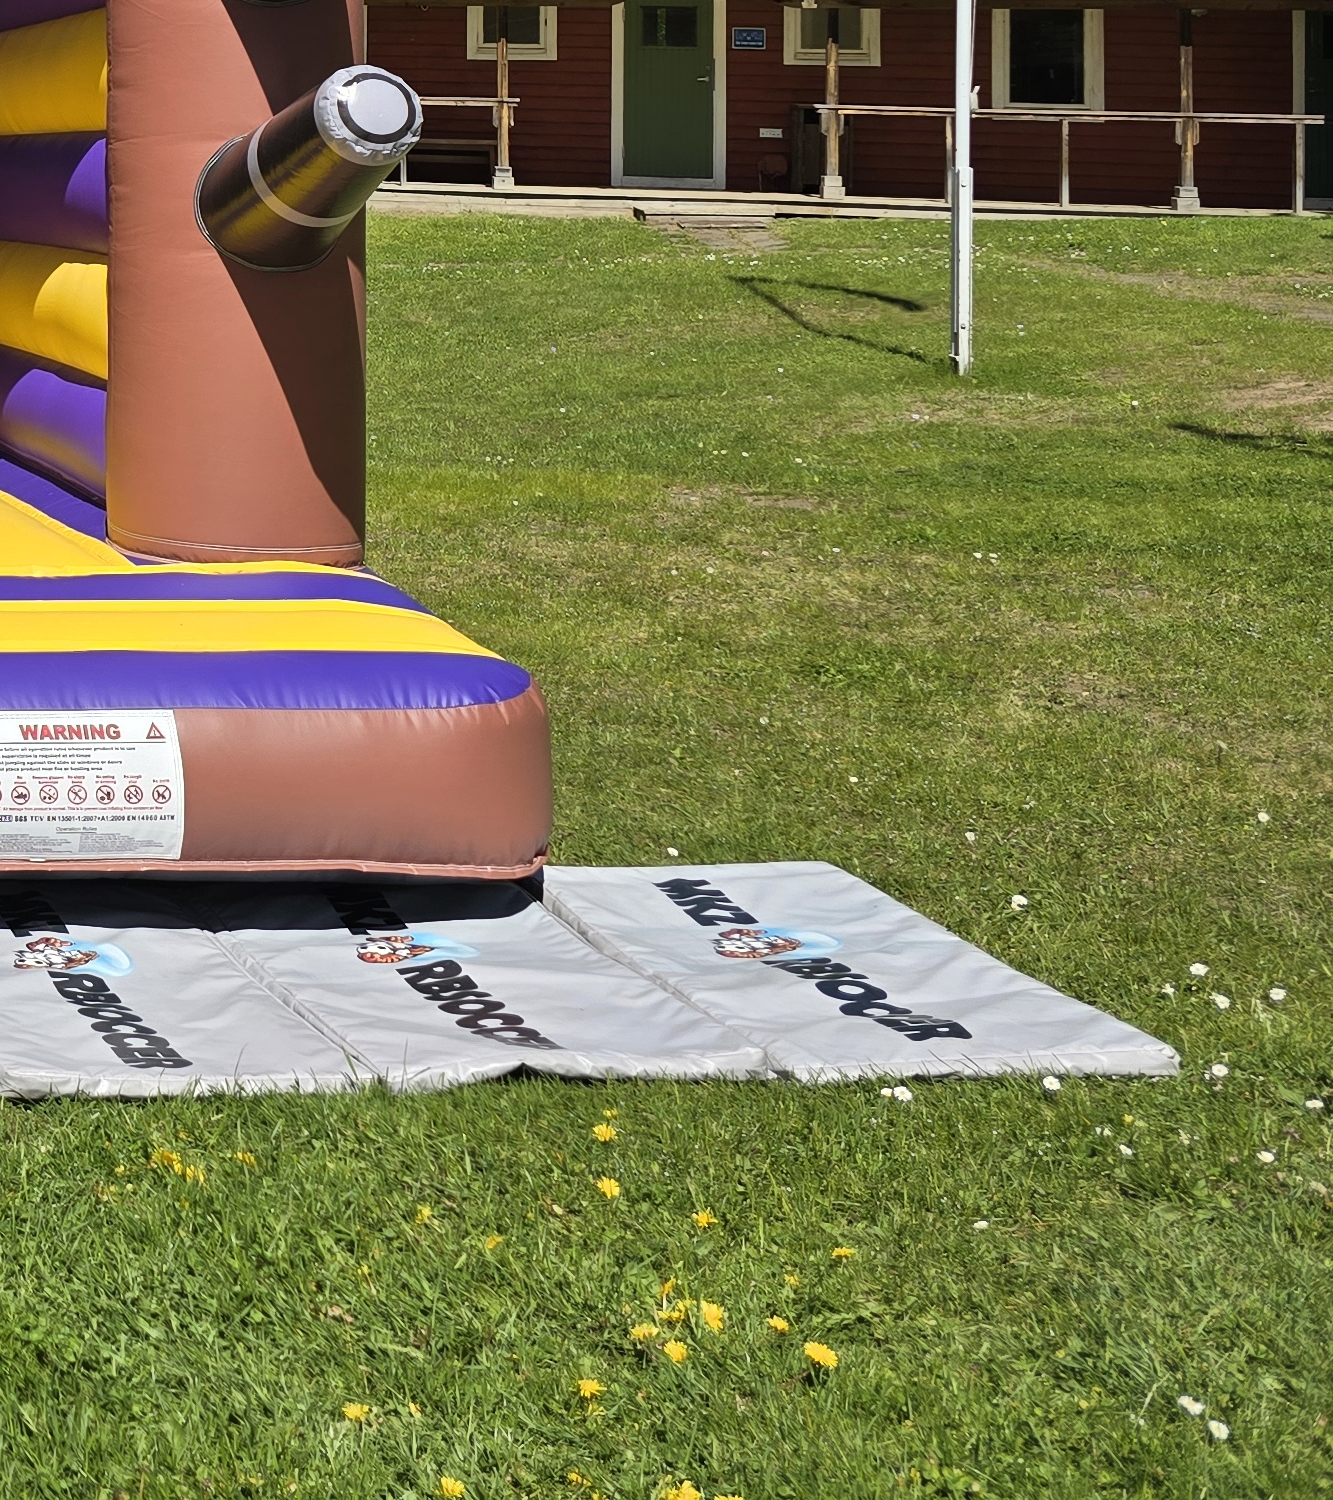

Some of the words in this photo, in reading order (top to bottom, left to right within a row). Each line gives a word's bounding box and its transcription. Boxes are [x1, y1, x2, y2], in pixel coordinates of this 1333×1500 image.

[19, 723, 121, 741] WARNING
[652, 878, 759, 926] MKZ
[47, 970, 193, 1069] RBSOCCER
